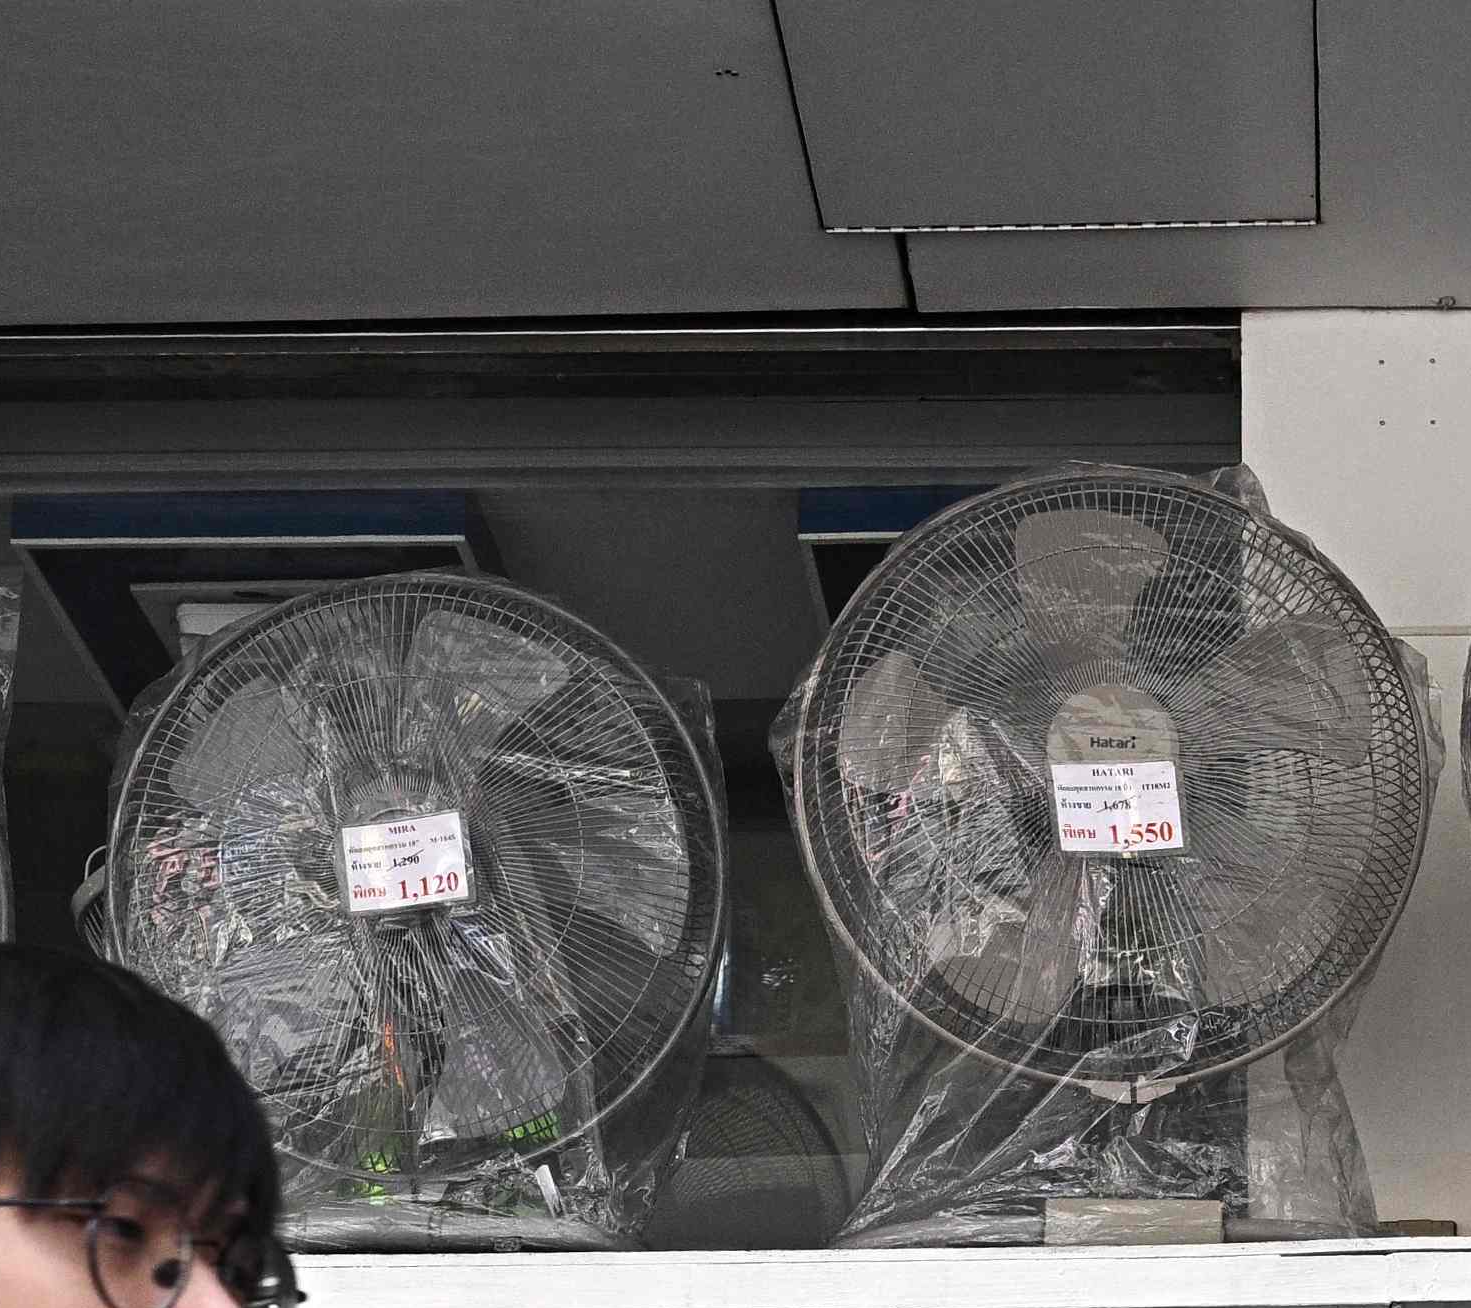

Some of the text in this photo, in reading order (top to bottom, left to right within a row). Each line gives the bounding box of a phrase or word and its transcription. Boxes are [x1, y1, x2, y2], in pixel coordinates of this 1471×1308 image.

[1090, 736, 1136, 749] Hatari
[1092, 768, 1134, 776] HATARI
[388, 825, 416, 835] MIRA
[1063, 821, 1174, 849] พิเศษ 1,550
[353, 871, 459, 901] พิเศษ 1,120
